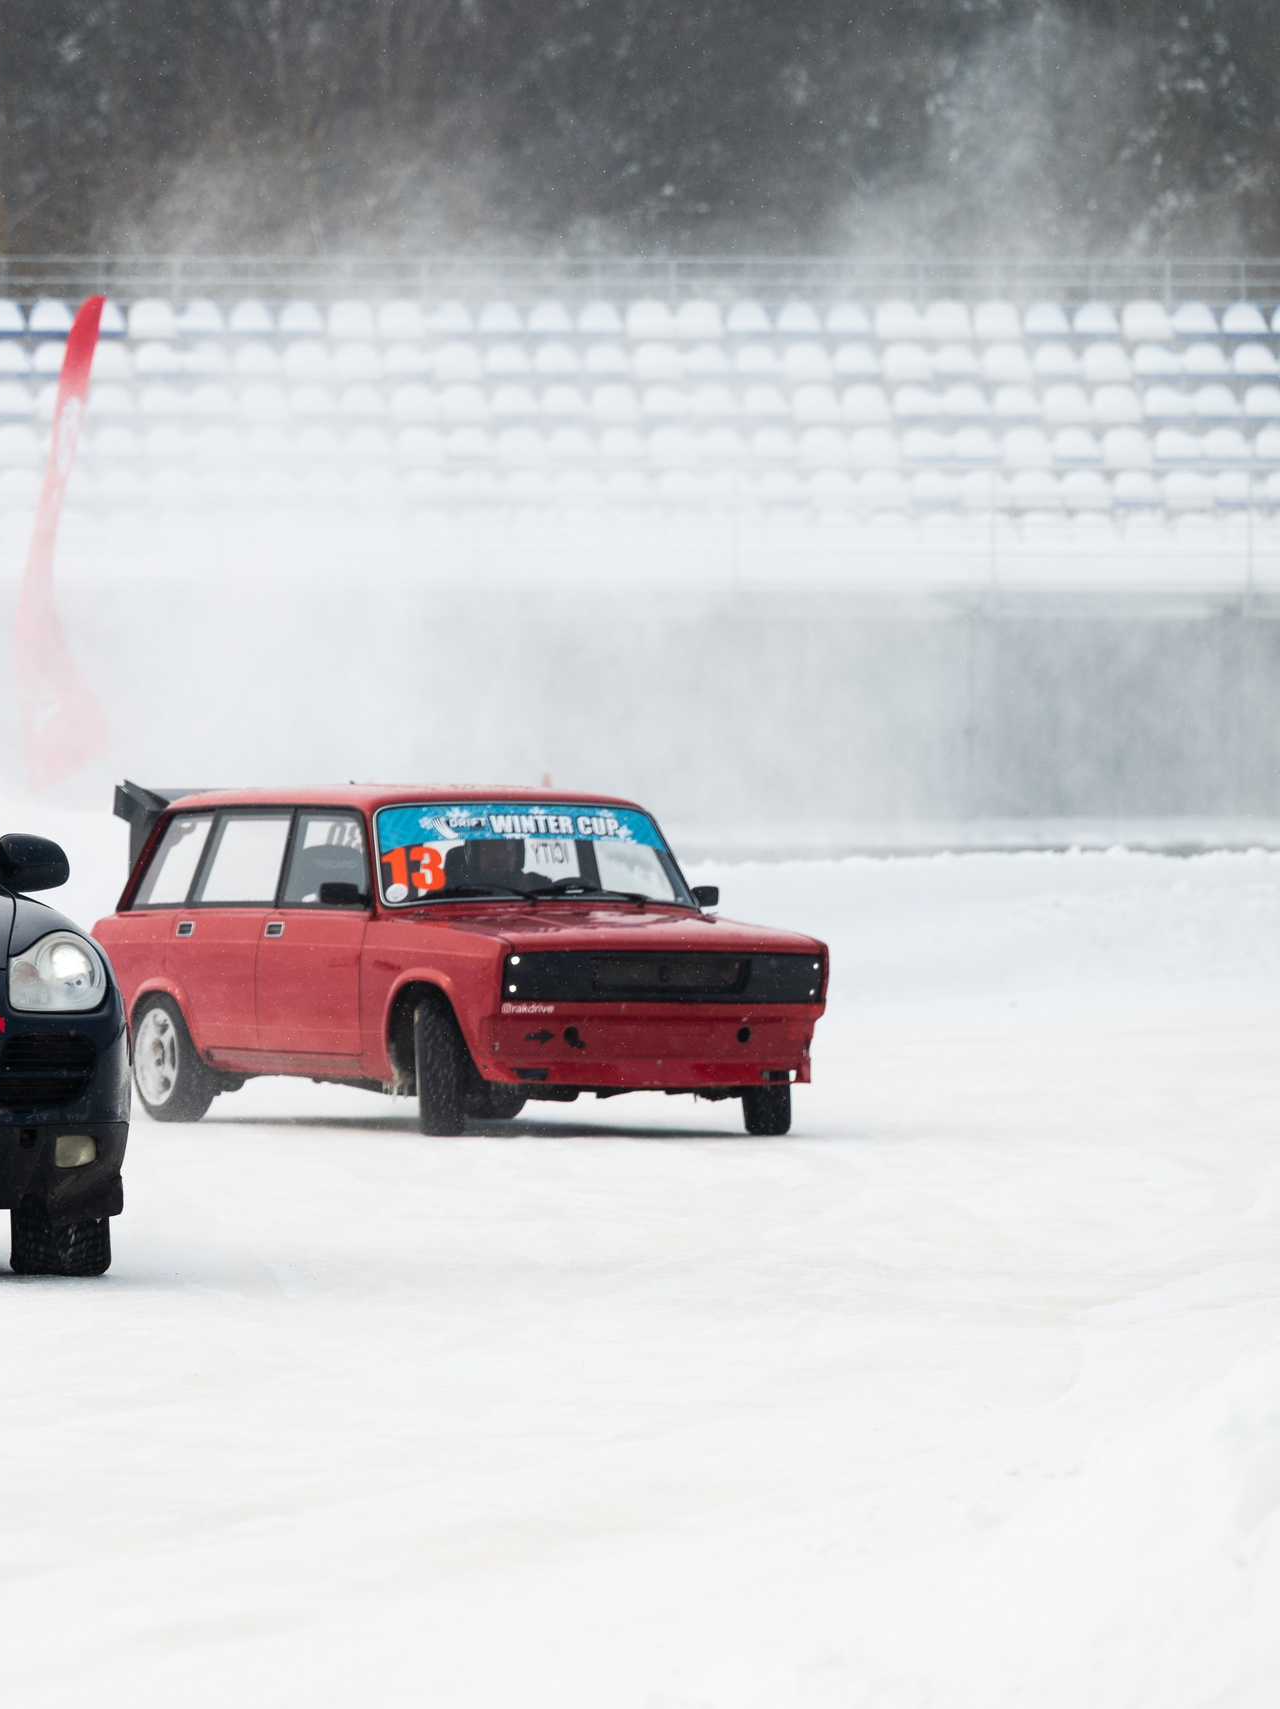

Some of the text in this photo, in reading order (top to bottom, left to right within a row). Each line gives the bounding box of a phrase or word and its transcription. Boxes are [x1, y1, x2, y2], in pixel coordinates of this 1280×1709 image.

[449, 814, 620, 836] DRIFT WINTER CUP
[381, 846, 446, 891] 13
